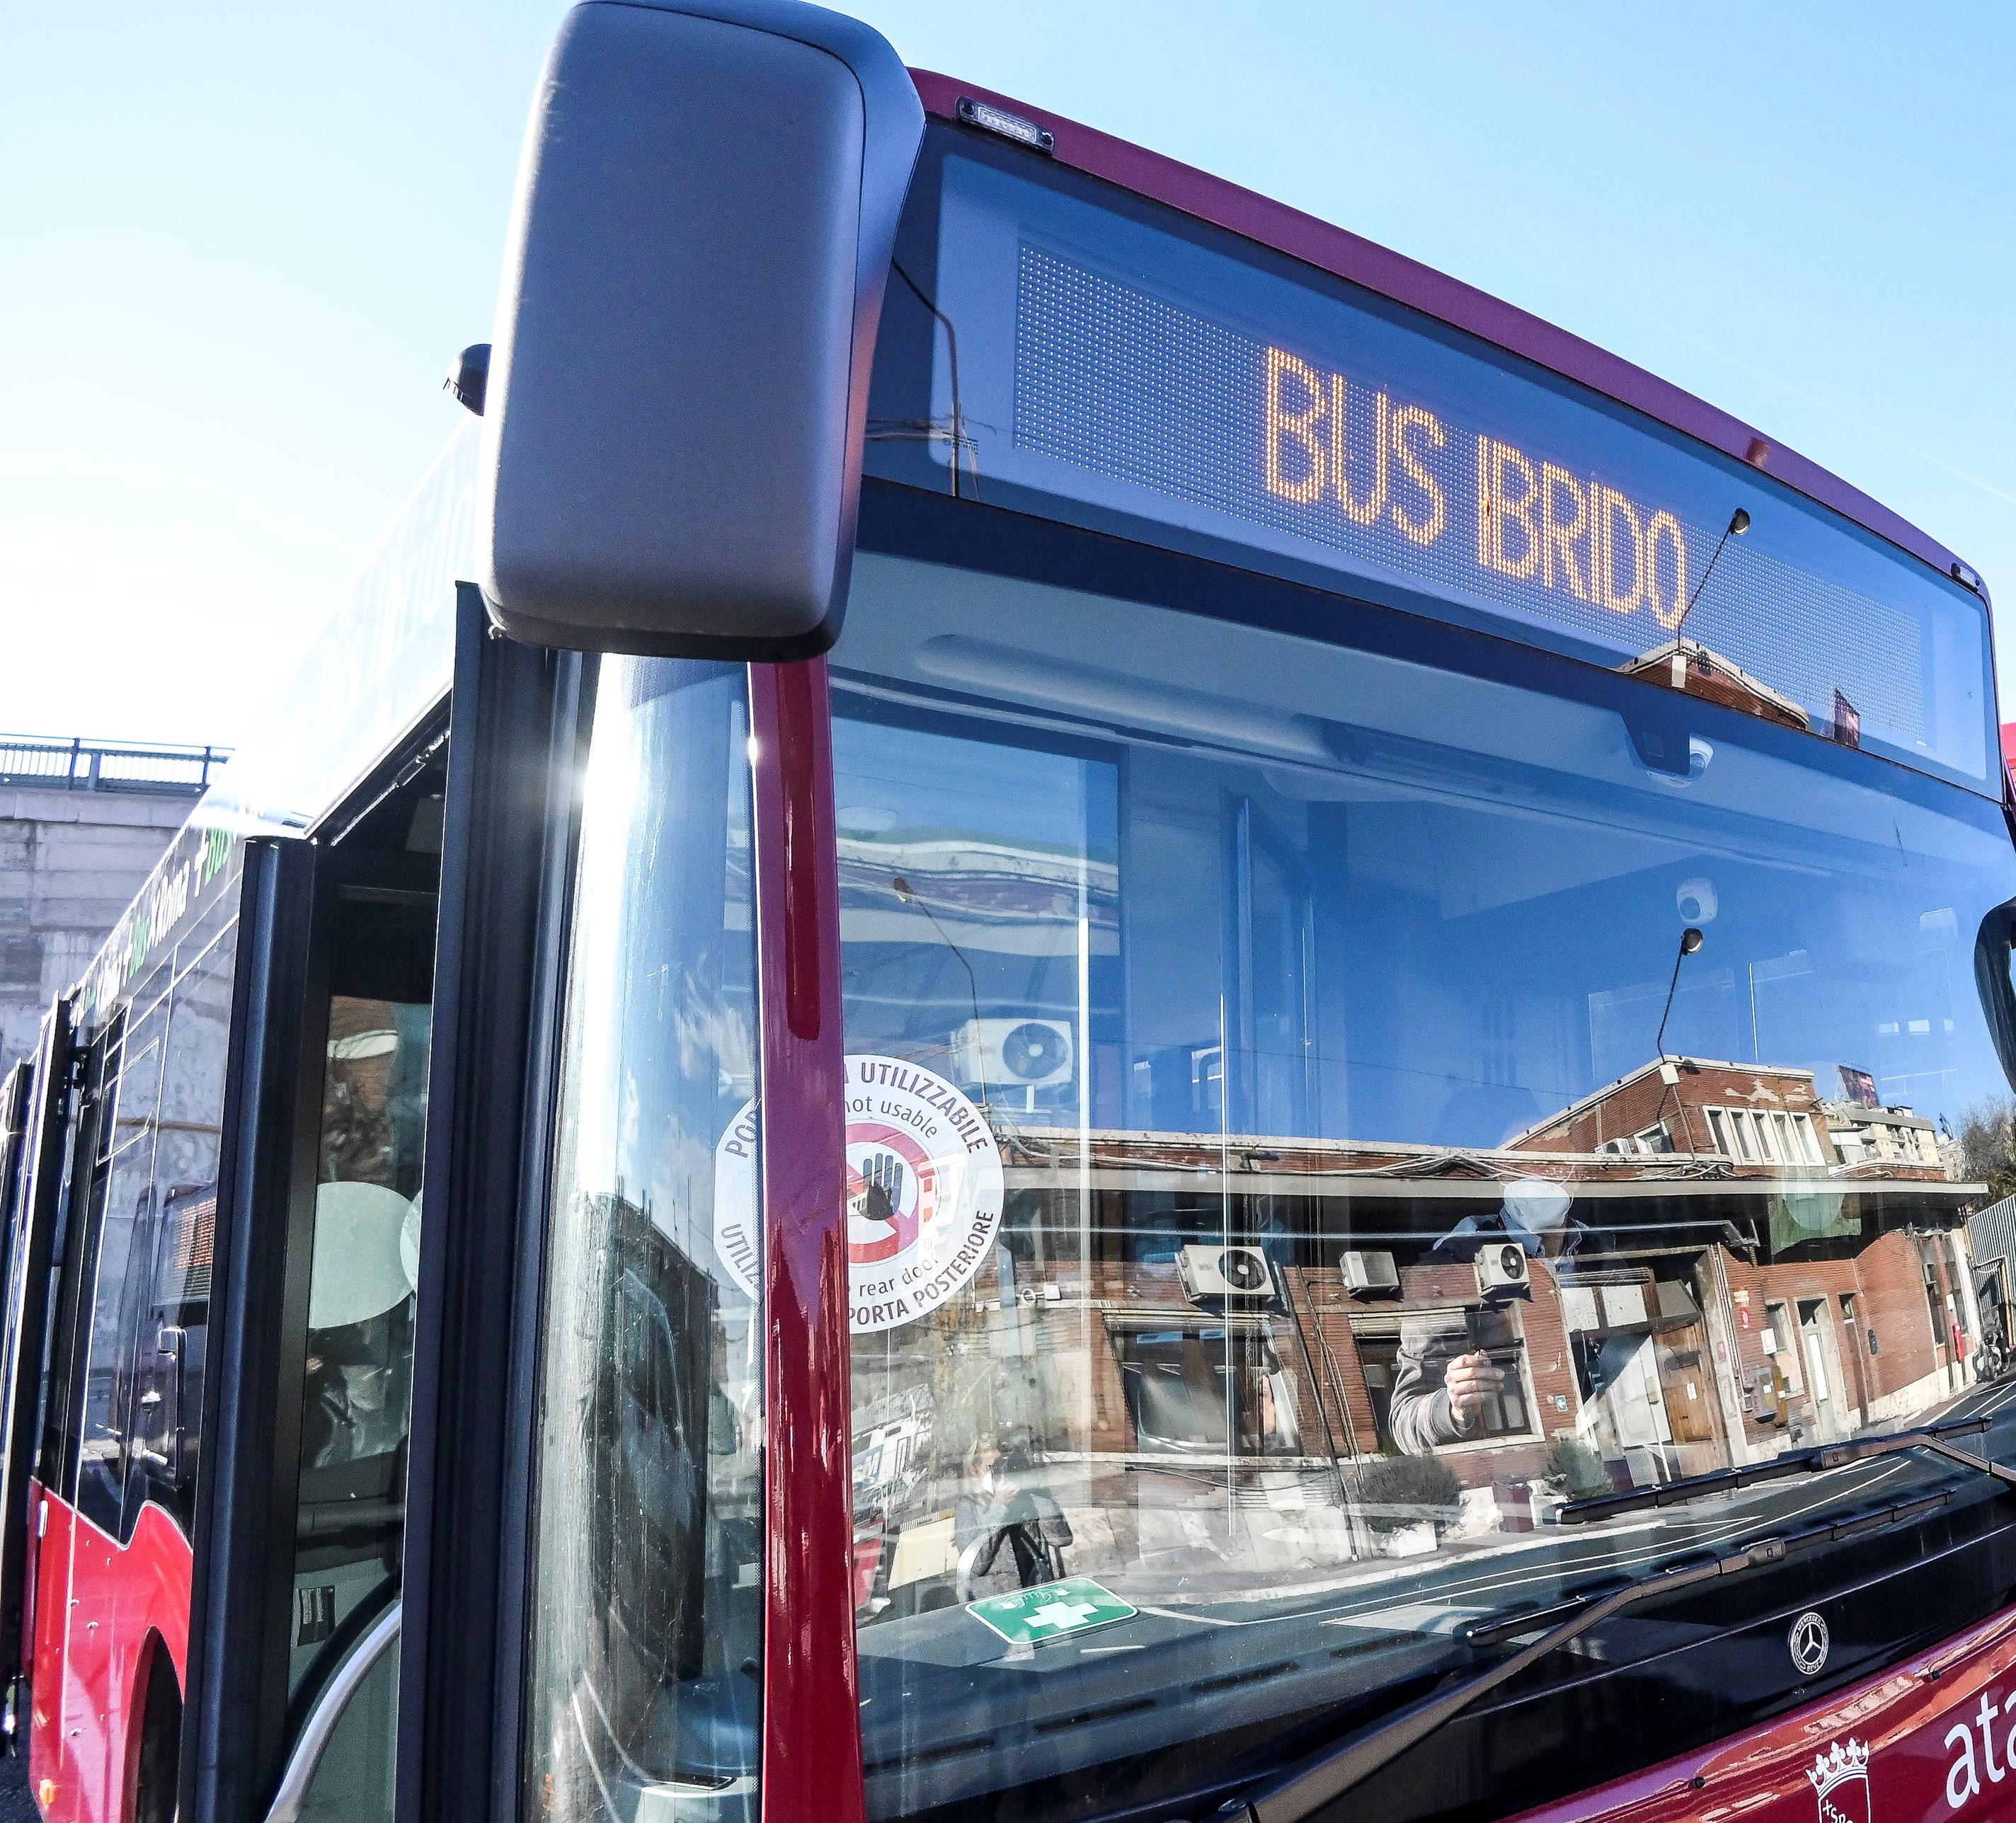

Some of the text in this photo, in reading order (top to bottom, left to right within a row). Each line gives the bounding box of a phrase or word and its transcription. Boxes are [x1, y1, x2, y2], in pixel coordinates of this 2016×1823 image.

[1267, 345, 1686, 631] BUS IBRIDO
[861, 1062, 988, 1154] UTILIZZABILE
[881, 1100, 937, 1139] usable
[859, 1254, 939, 1297] rear door
[912, 1210, 994, 1307] POSTERIORE
